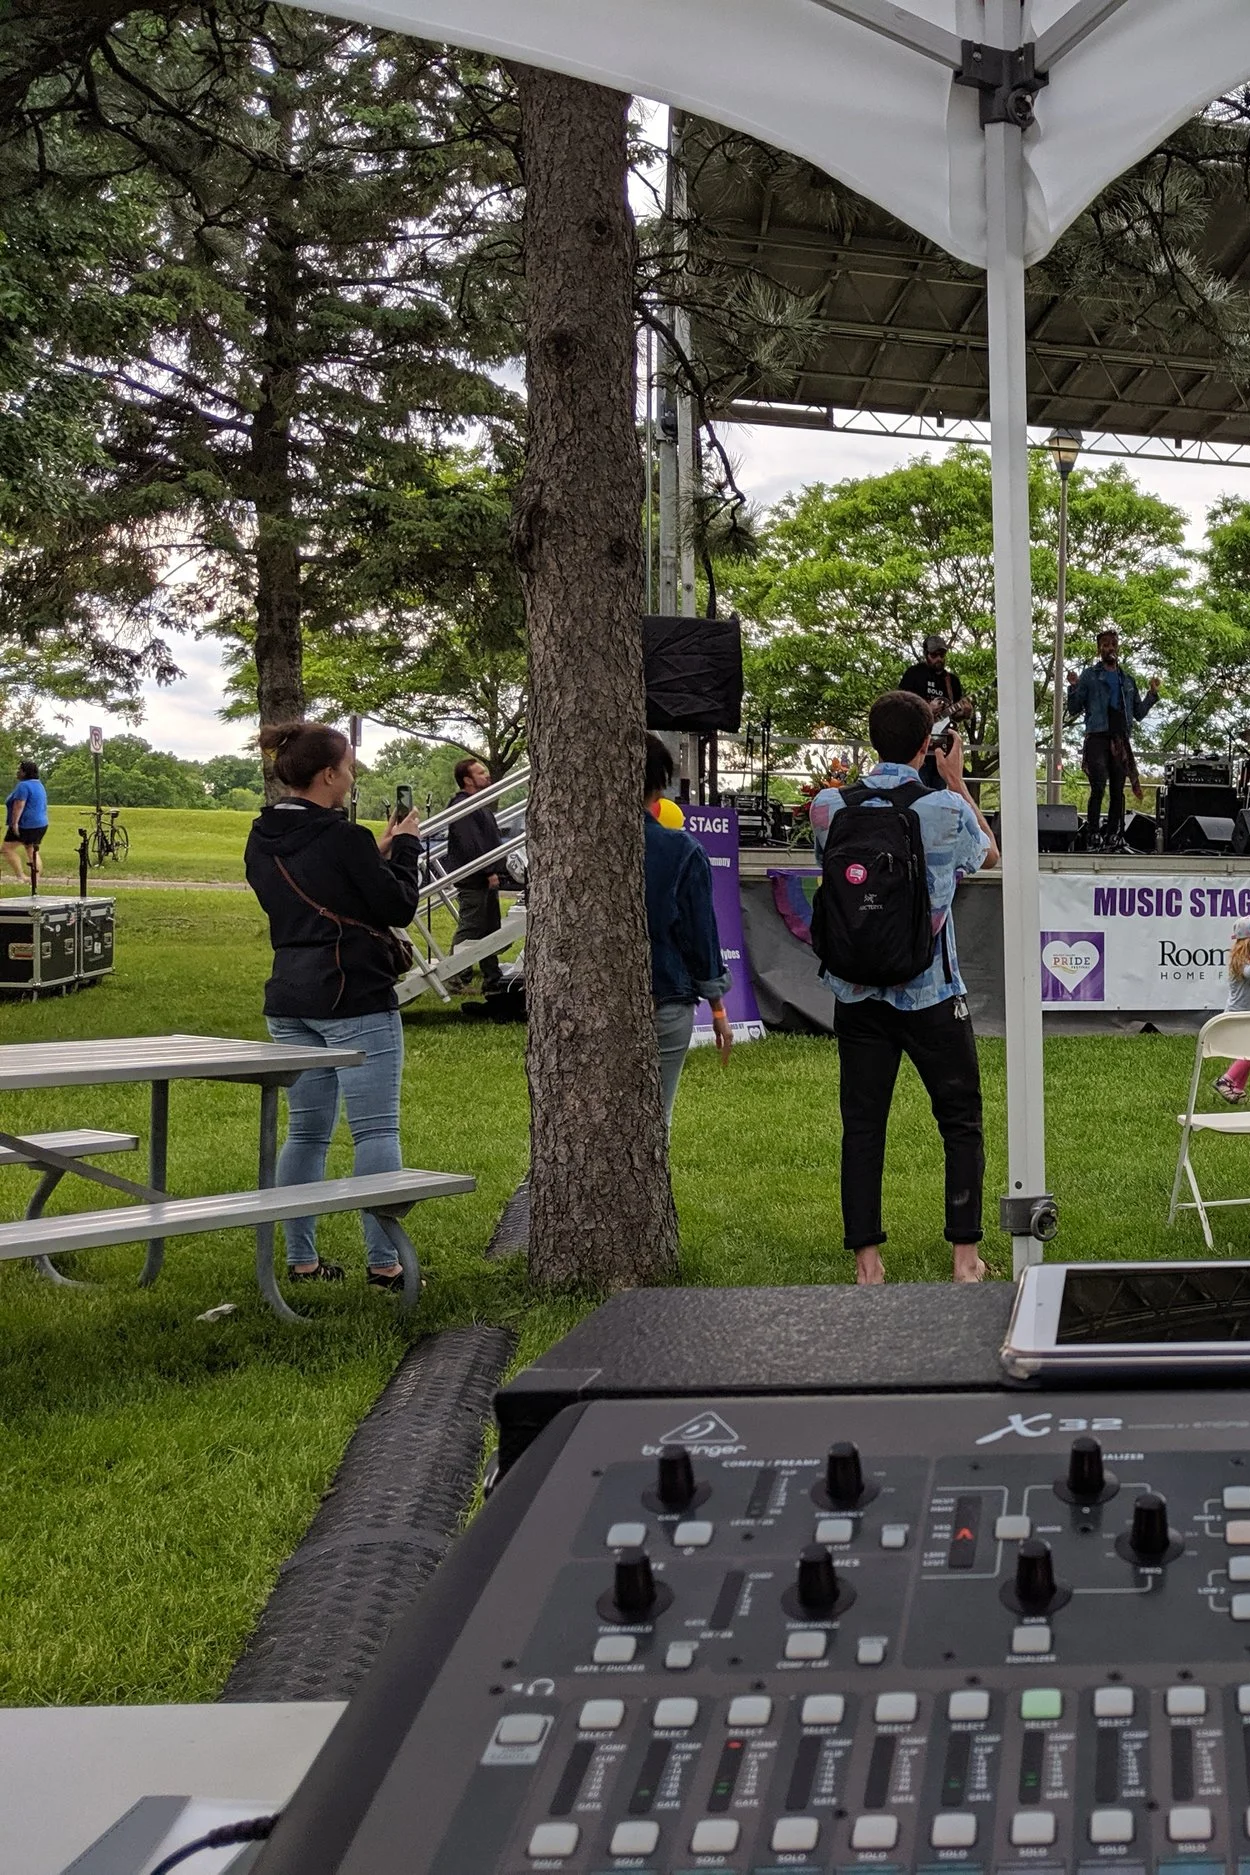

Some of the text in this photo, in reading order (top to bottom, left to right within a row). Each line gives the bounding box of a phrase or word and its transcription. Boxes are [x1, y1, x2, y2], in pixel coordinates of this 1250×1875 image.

[689, 816, 729, 834] STAGE
[1093, 887, 1183, 917] MUSIC
[1053, 956, 1091, 966] PRIDE
[1160, 971, 1205, 980] HOME
[777, 1854, 806, 1863] SOLO
[857, 1852, 888, 1861] SOLO
[939, 1850, 968, 1859] SOLO
[532, 1860, 562, 1869] SOLO
[614, 1858, 645, 1867] SOLO
[695, 1856, 727, 1865] SOLO
